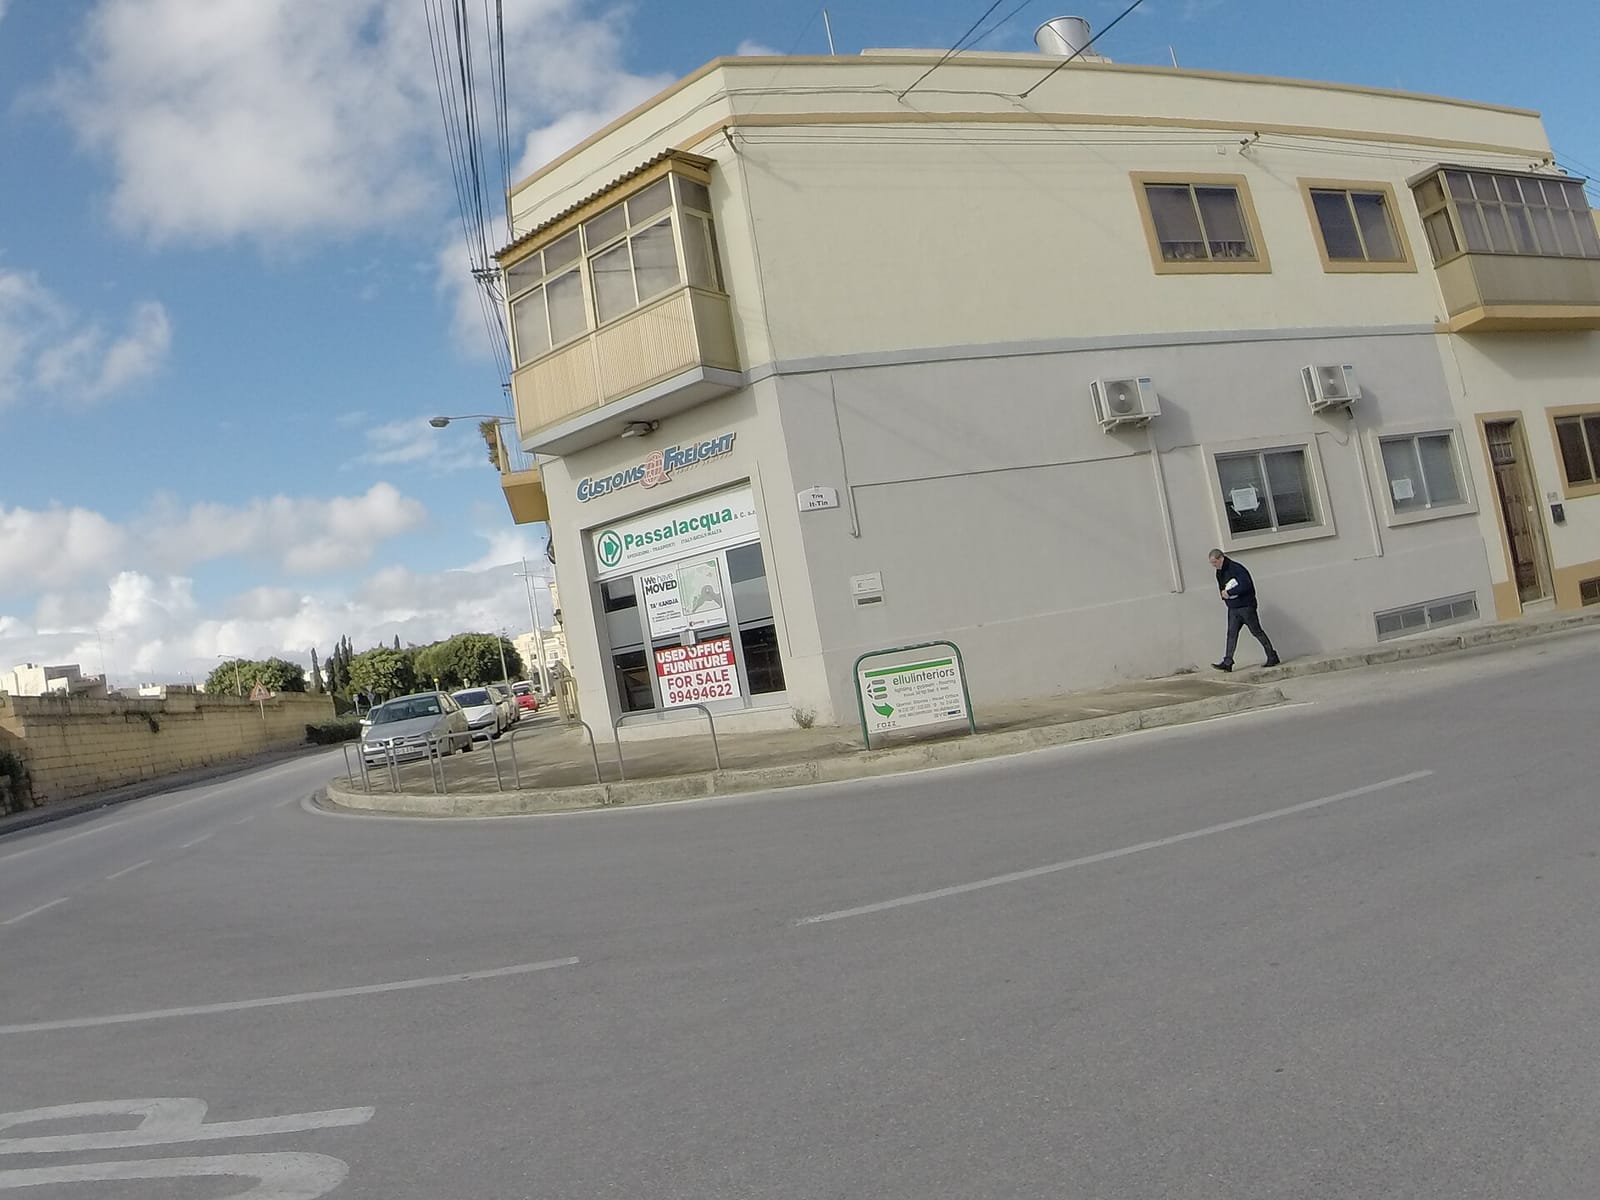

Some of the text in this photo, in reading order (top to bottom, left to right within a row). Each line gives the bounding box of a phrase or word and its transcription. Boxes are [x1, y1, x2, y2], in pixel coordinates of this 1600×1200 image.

[663, 432, 735, 471] FREIGHT
[624, 508, 733, 549] Passalacqua
[644, 573, 674, 586] We have
[645, 579, 678, 596] MOVED
[656, 639, 731, 663] USED OFFICE
[663, 653, 729, 675] FURNITURE
[667, 669, 730, 690] FOR SALE
[670, 684, 732, 703] 99494622
